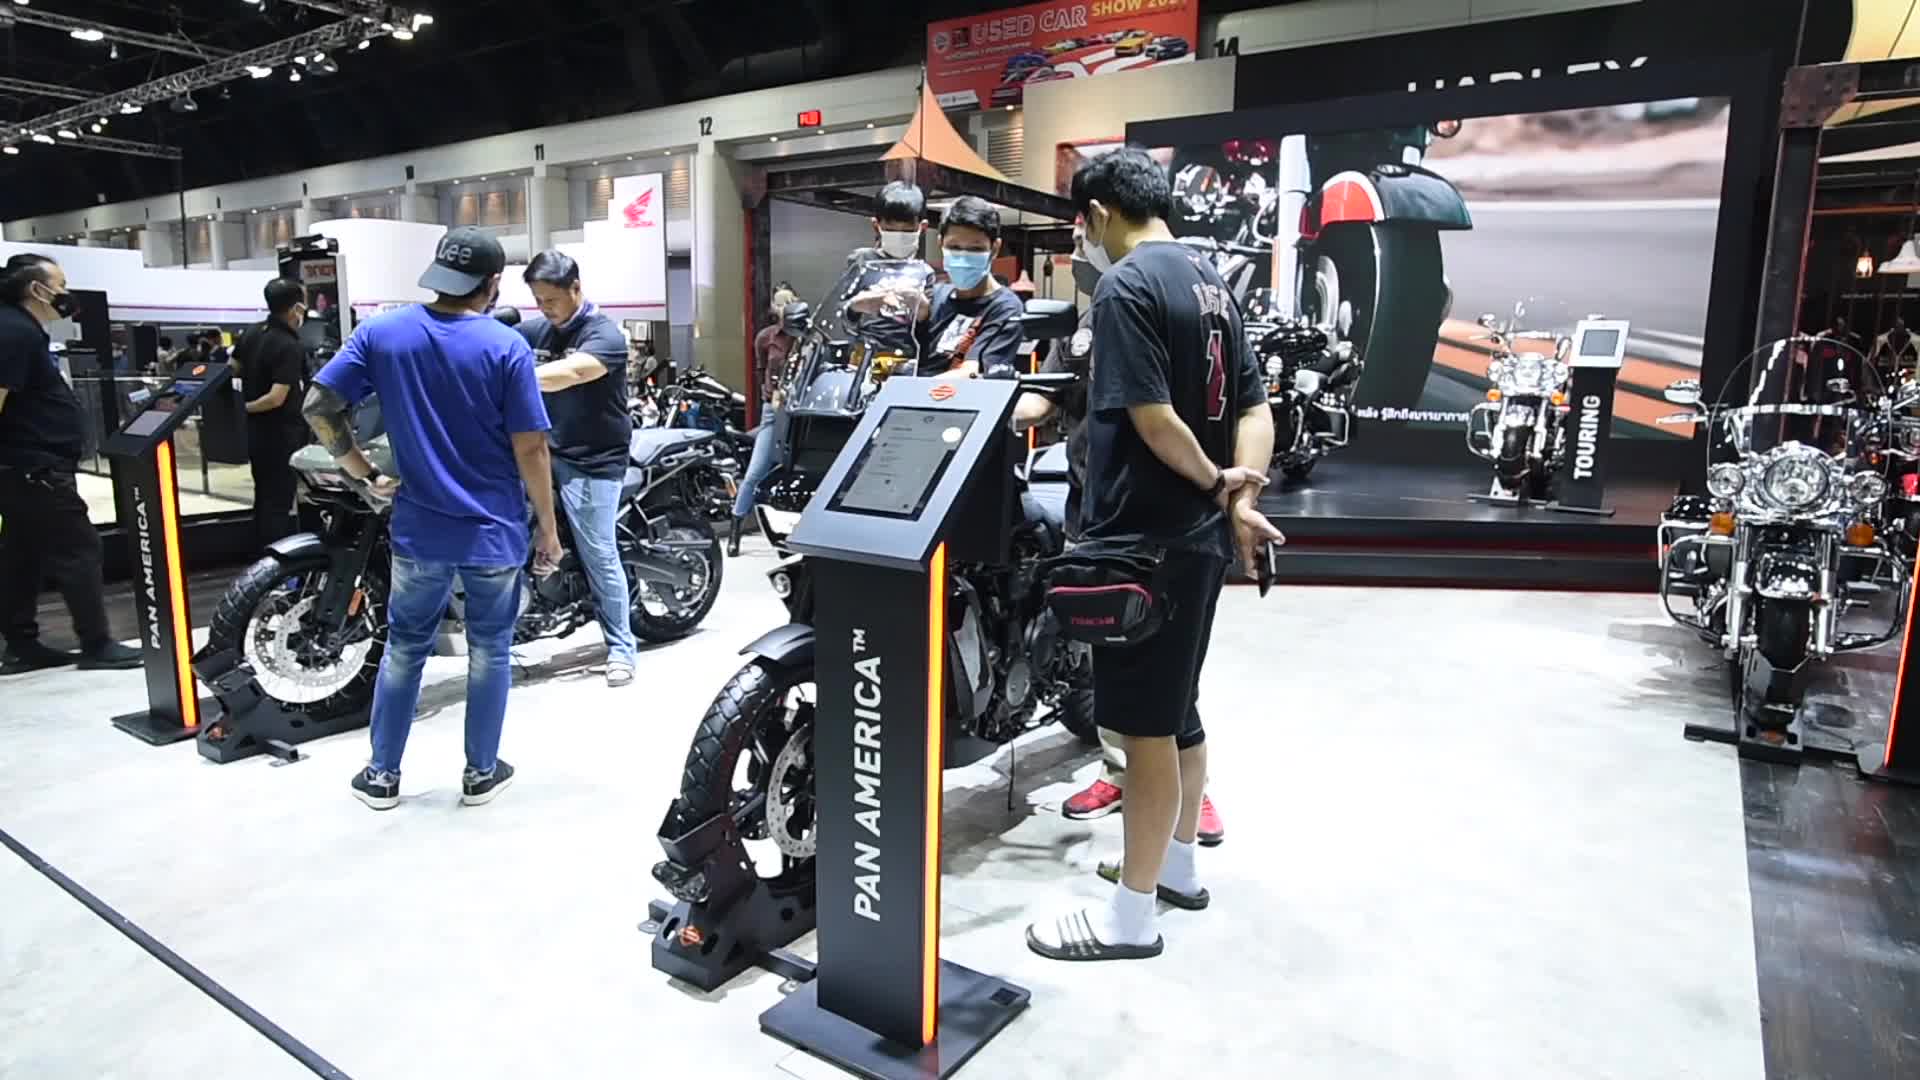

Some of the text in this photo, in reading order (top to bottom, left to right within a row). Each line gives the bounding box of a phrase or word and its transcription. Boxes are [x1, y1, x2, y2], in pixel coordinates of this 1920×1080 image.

[970, 15, 1035, 45] USED
[1040, 5, 1088, 32] CAR
[1092, 0, 1142, 17] SHOW
[698, 116, 713, 136] 12
[438, 240, 473, 265] Lee
[1573, 395, 1601, 480] TOURING
[148, 605, 161, 649] PAN
[854, 842, 881, 921] PAN
